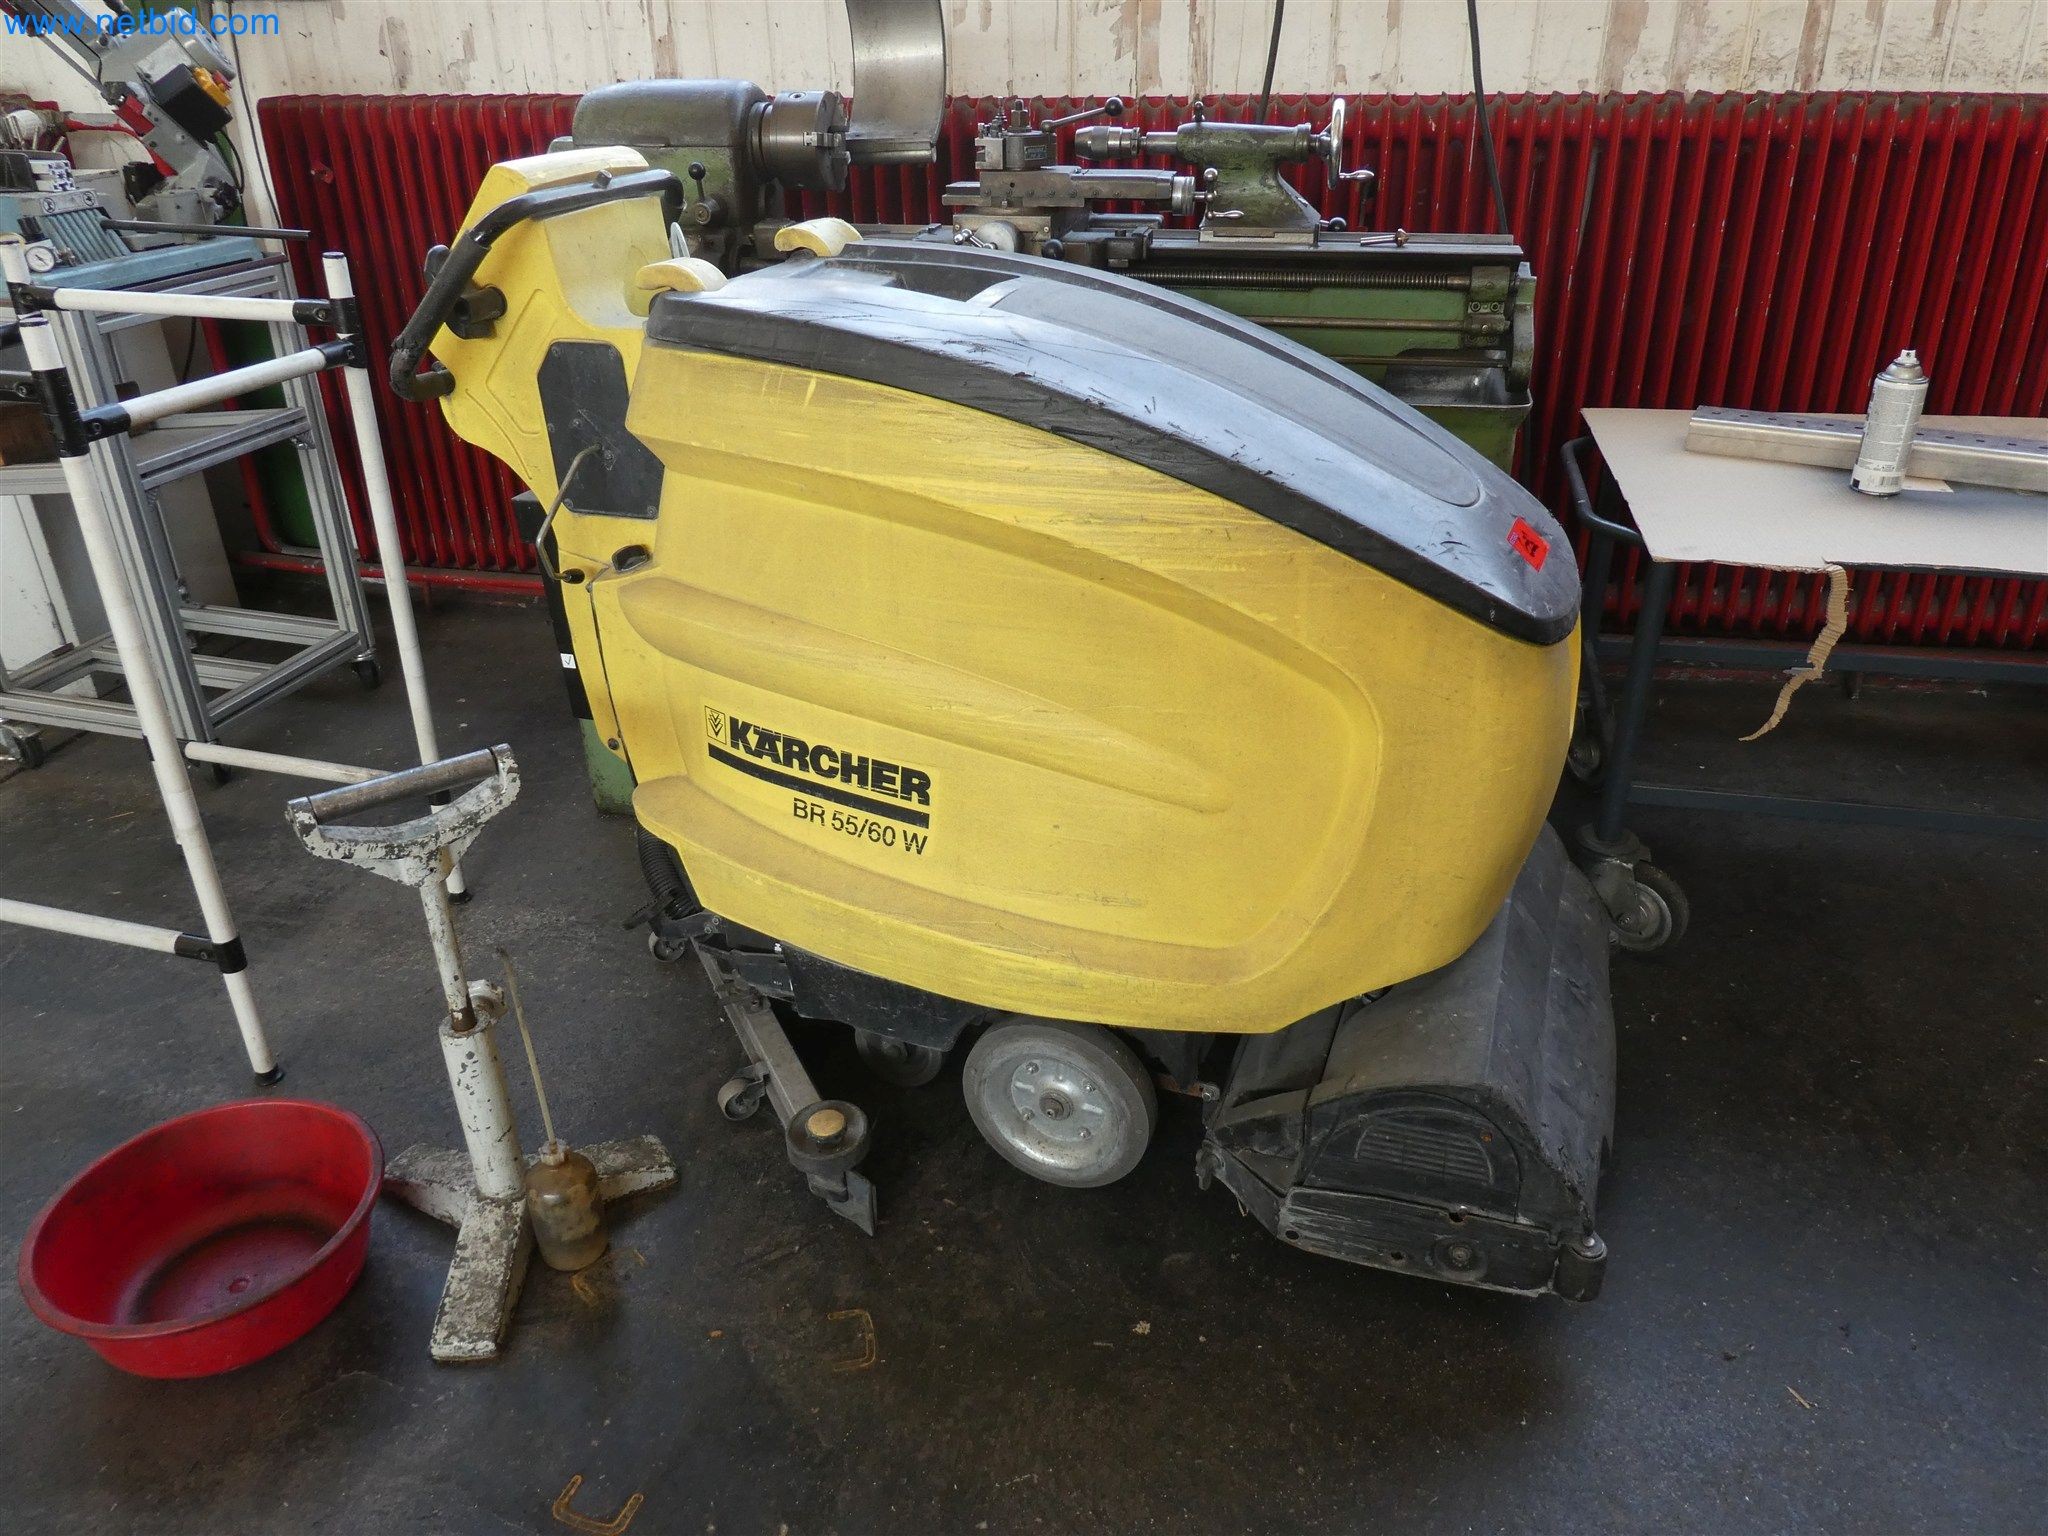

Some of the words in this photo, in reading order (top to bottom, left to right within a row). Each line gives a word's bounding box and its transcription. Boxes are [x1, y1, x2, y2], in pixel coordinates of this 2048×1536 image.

[729, 716, 931, 806] KÄRCHER
[793, 797, 825, 827] BR
[831, 810, 896, 847] 55/60
[902, 829, 928, 855] W
